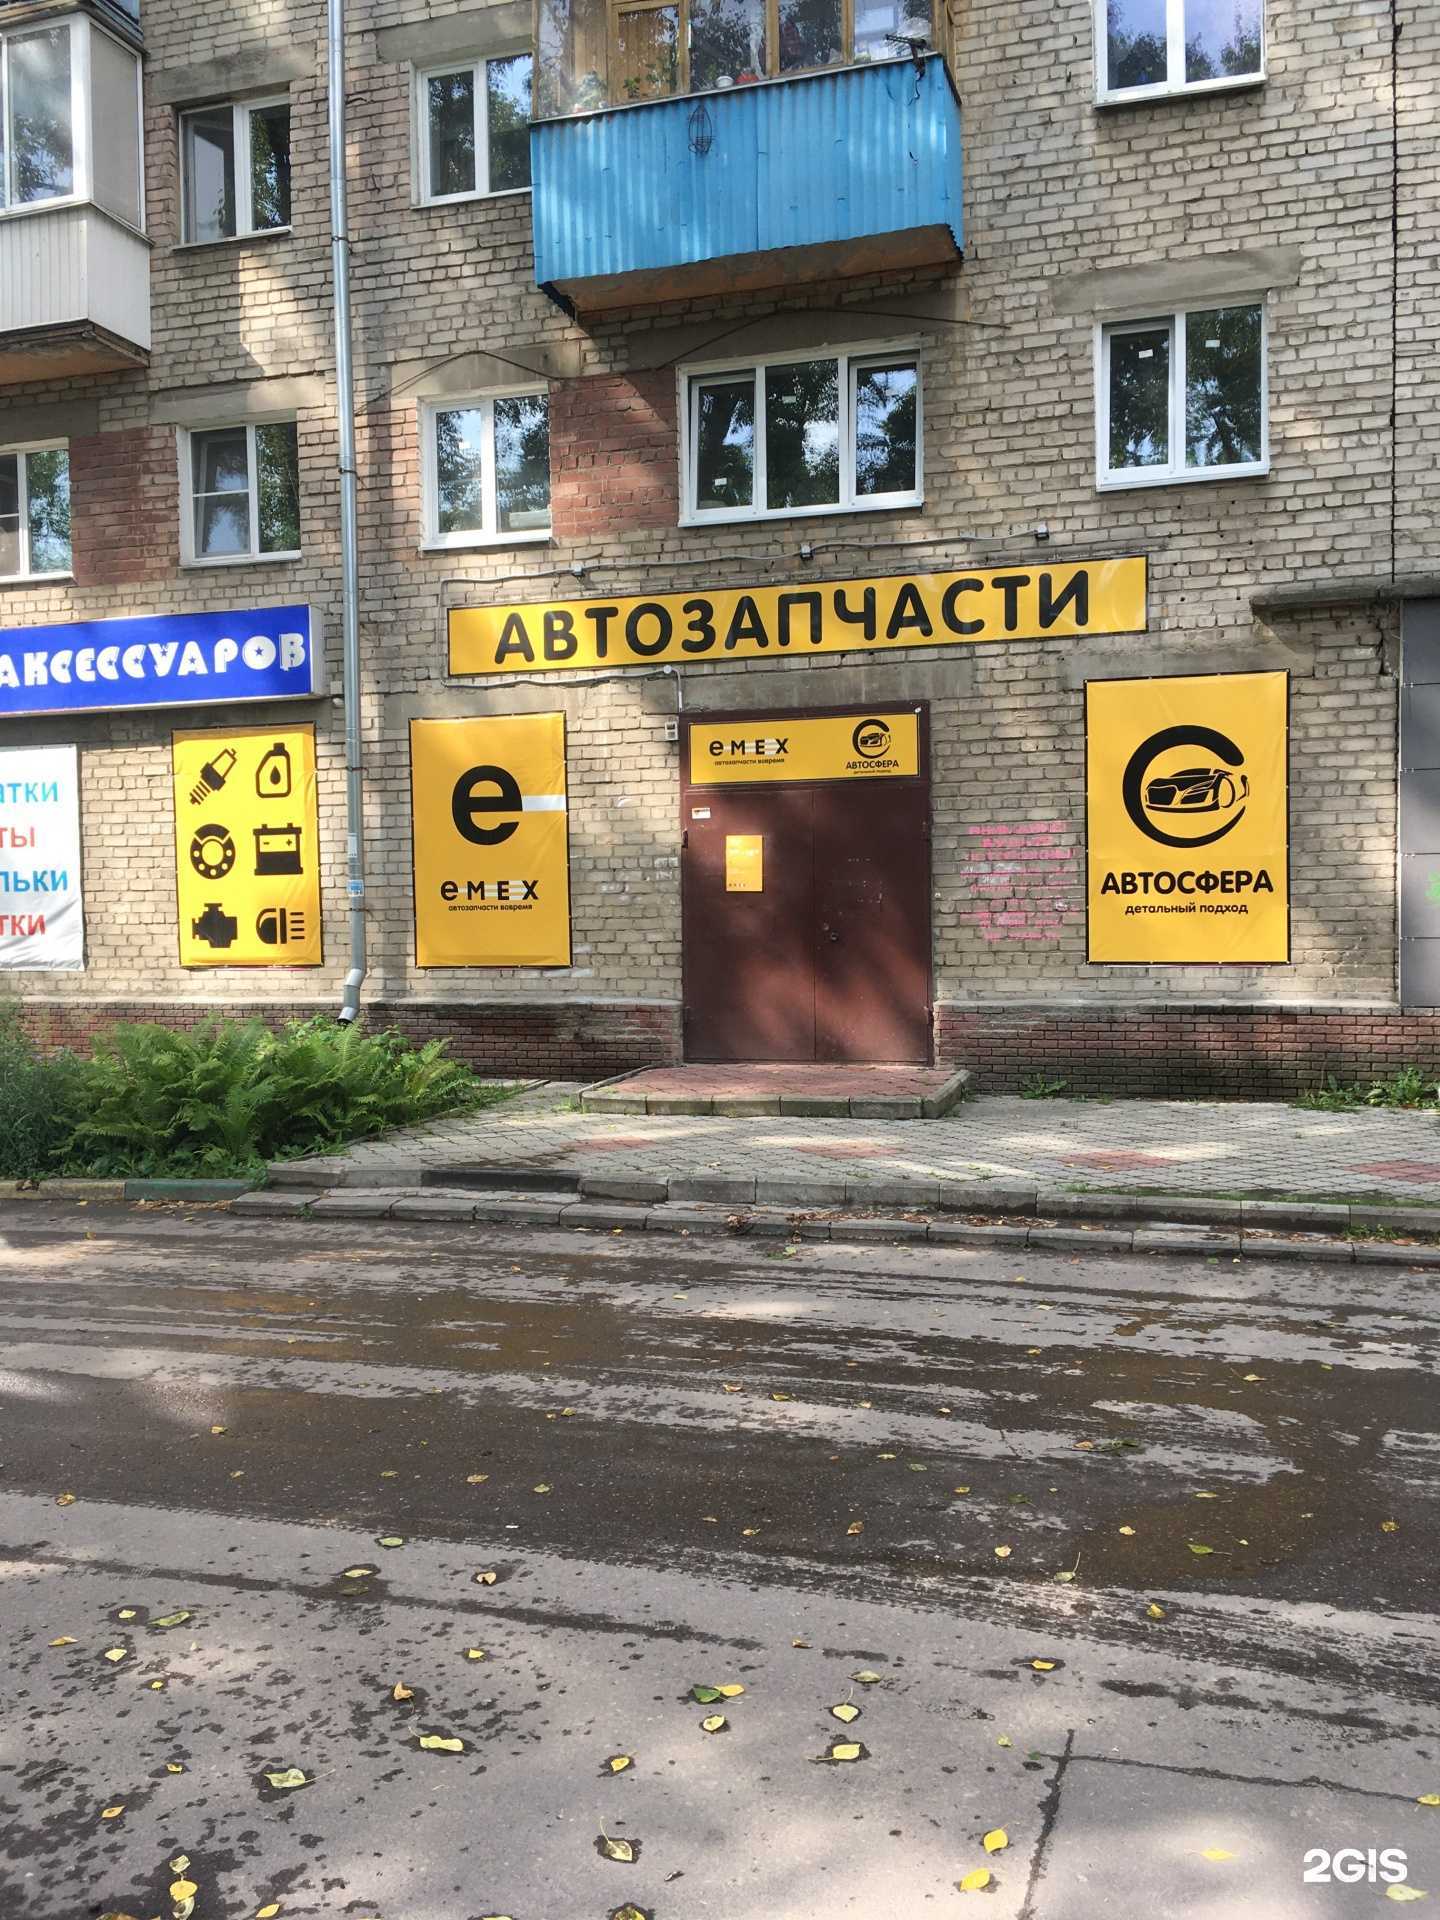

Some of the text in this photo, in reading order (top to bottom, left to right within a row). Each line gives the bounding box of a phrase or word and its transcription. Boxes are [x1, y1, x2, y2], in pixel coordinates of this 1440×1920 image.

[494, 570, 1089, 665] АВТОЗАПЧАСТИ
[846, 760, 899, 769] АВТОСФЕРА
[0, 782, 59, 803] тки
[1101, 869, 1274, 894] АВТОСФЕРА
[500, 904, 533, 912] вовремя
[1125, 902, 1248, 915] детальный подход
